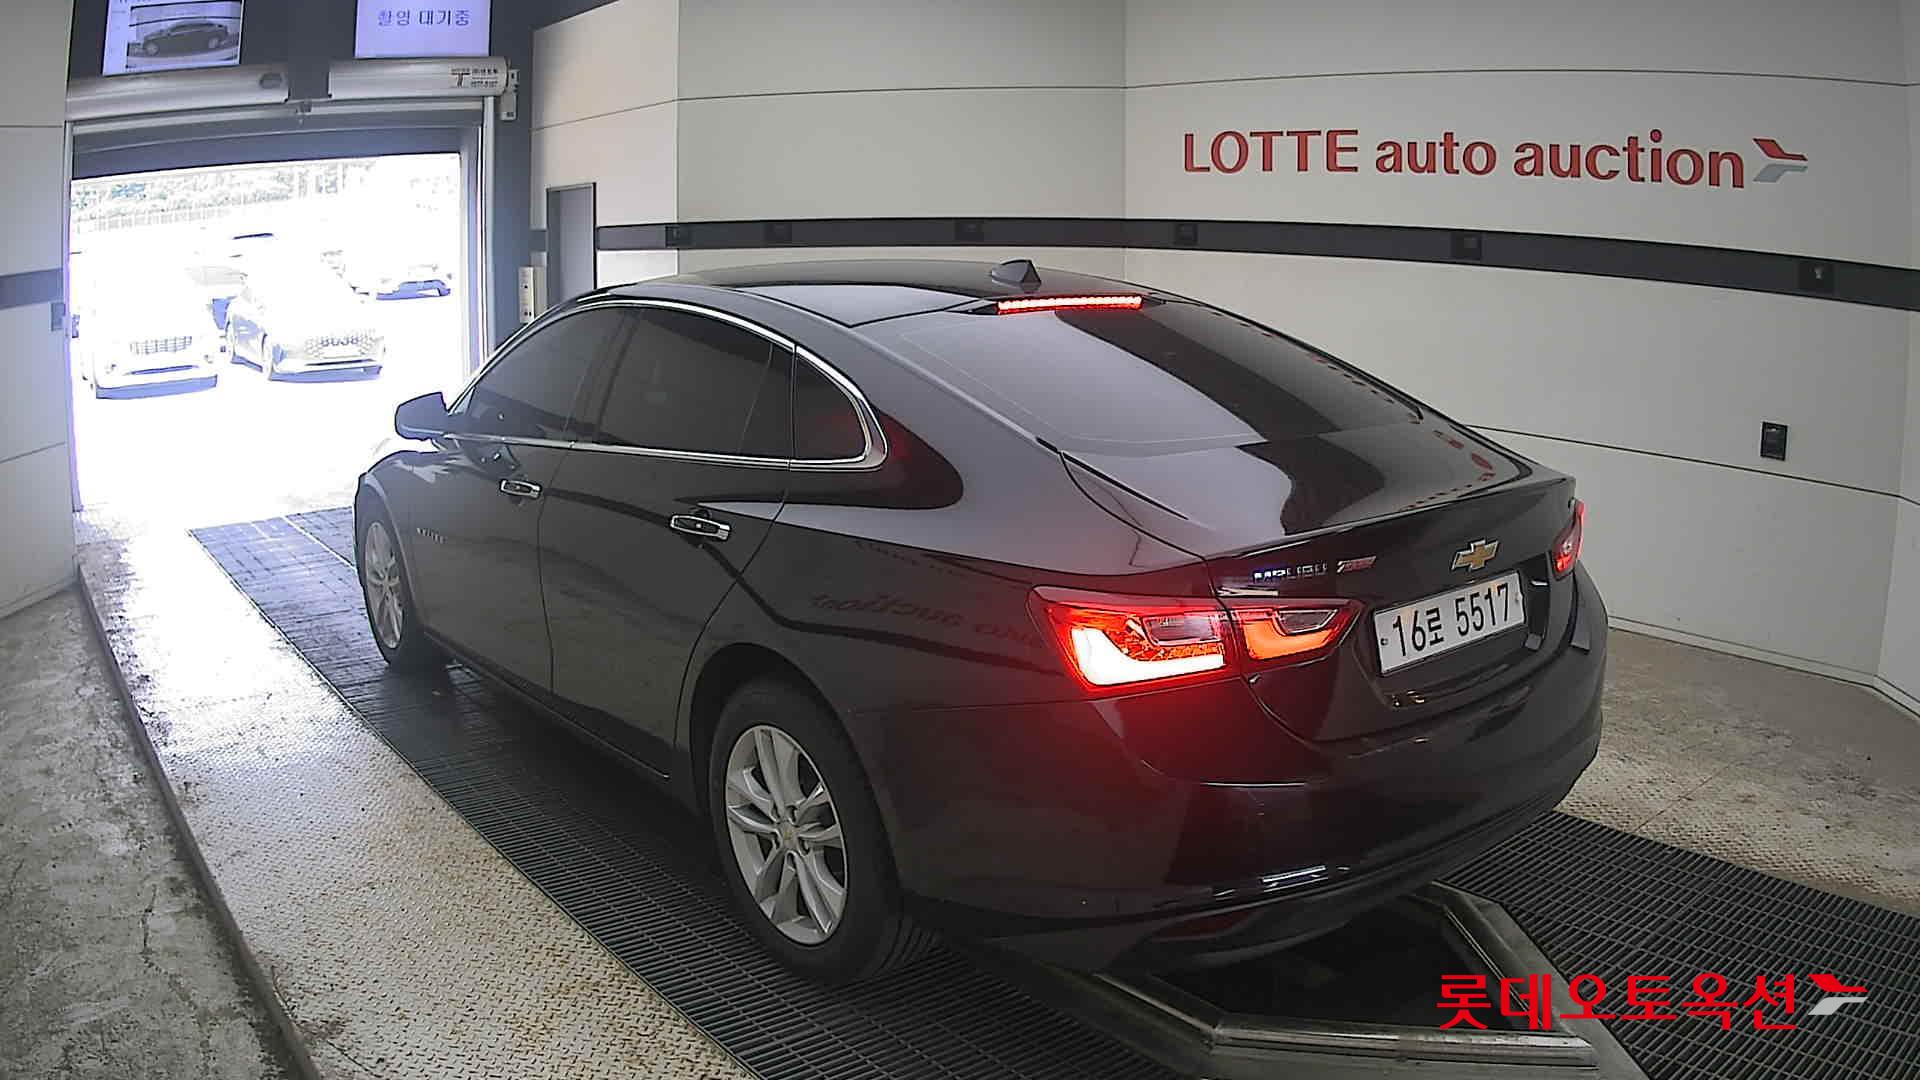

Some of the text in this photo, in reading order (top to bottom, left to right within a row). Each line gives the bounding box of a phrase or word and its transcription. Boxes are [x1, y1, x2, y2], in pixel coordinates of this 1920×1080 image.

[418, 9, 472, 27] 대기중
[1184, 129, 1745, 189] LOTTE auto auction
[1392, 583, 1511, 657] 16로 5517
